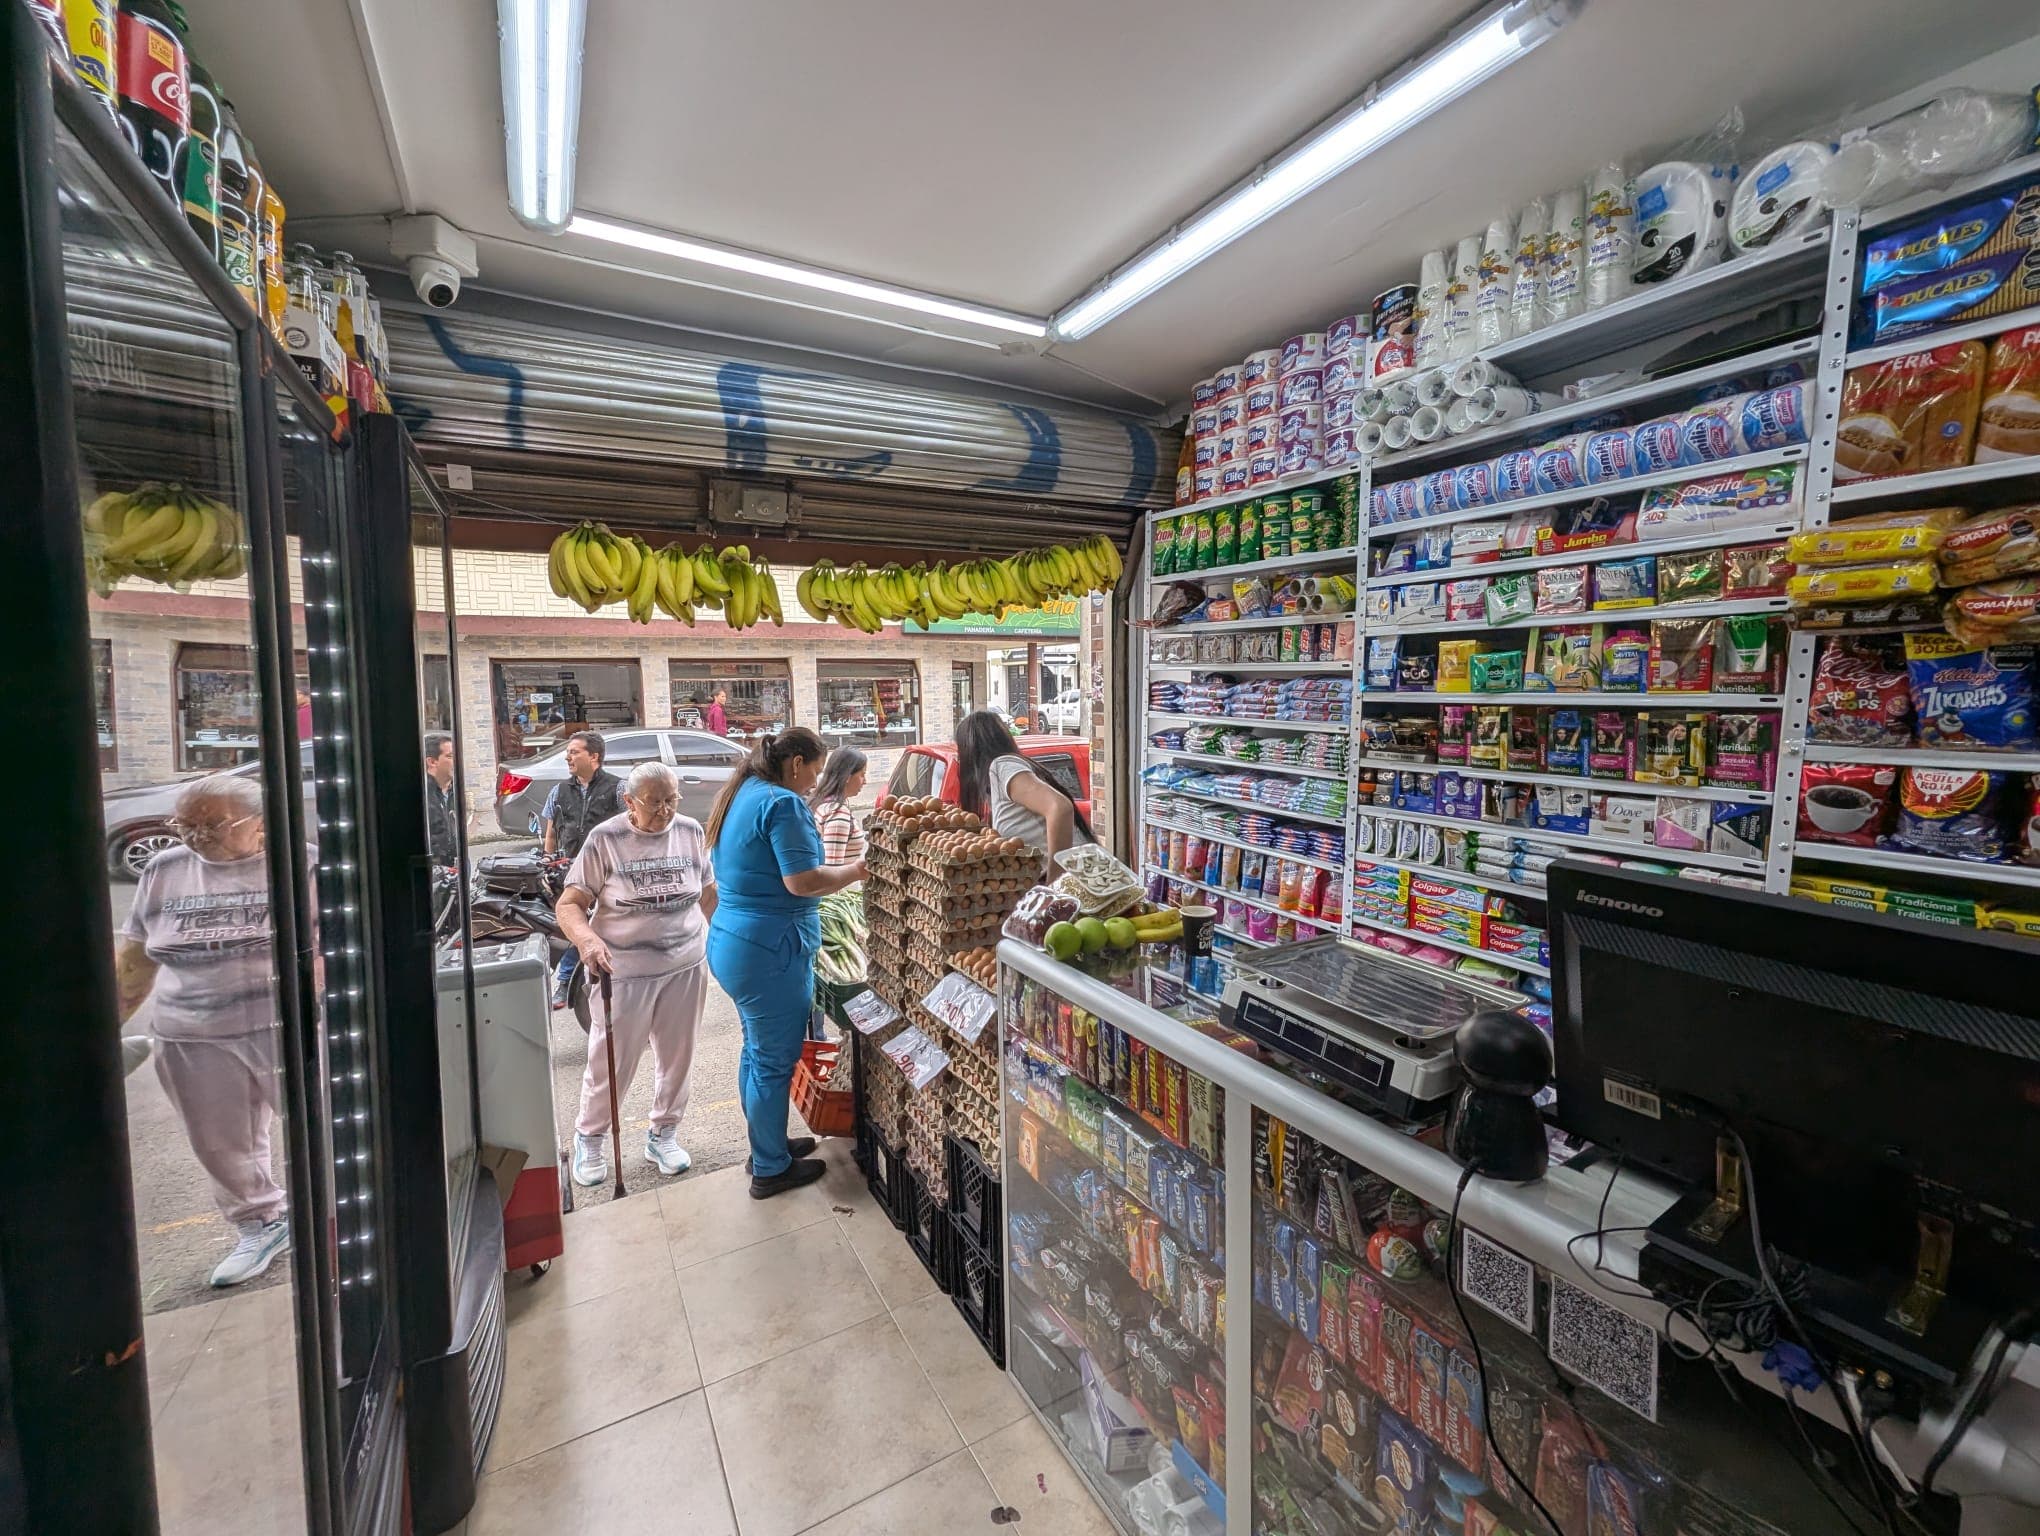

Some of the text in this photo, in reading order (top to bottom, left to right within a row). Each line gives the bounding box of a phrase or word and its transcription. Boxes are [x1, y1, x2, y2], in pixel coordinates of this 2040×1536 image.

[1591, 240, 1612, 253] Vaso
[1896, 219, 1983, 261] DUCALES
[1903, 270, 1989, 307] DUCALES
[1246, 365, 1263, 378] Elite
[1217, 378, 1232, 391] Elite
[1197, 388, 1214, 400] Elite
[1251, 397, 1270, 408] Elite
[1221, 409, 1236, 420] Elite
[1197, 420, 1214, 432] Elite
[1249, 429, 1264, 441] Elite
[1695, 421, 1715, 461] amilia
[1197, 451, 1212, 462] Elite
[1254, 461, 1273, 472] Elite
[1225, 472, 1245, 482] Elite
[1681, 478, 1744, 499] favorita
[1564, 534, 1607, 548] Jumbo
[1902, 535, 1917, 545] 24
[1949, 524, 2009, 547] COMAPAN
[1895, 575, 1908, 585] 24
[1966, 598, 2035, 615] COMAPAN
[1284, 630, 1293, 650] FAB
[1301, 631, 1309, 651] FAB
[1322, 628, 1331, 650] FAB
[1914, 644, 1966, 655] BOLSA
[1933, 668, 2001, 685] Kellogg's
[1715, 684, 1766, 693] NutriBela15
[1923, 684, 2007, 717] ZUCARITAS
[1709, 778, 1757, 789] NutriBela15
[1612, 805, 1642, 818] Dove
[1403, 828, 1415, 852] Protex
[631, 868, 684, 887] WEST
[638, 883, 680, 895] STREET
[1412, 880, 1448, 895] Colgate
[1832, 885, 1873, 899] CORONA
[1416, 904, 1444, 915] Colgate
[1576, 889, 1664, 918] lenovo
[1833, 898, 1874, 912] CORONA
[1894, 896, 1958, 913] Tradicional
[1896, 908, 1961, 926] Tradicional
[1415, 920, 1442, 932] Colgate
[1489, 938, 1519, 951] Colgate
[1167, 1067, 1178, 1137] Jumbo
[1174, 1183, 1183, 1220] OREO
[1194, 1195, 1204, 1233] OREO
[1272, 1271, 1283, 1310] OREO
[1298, 1291, 1308, 1332] OREO
